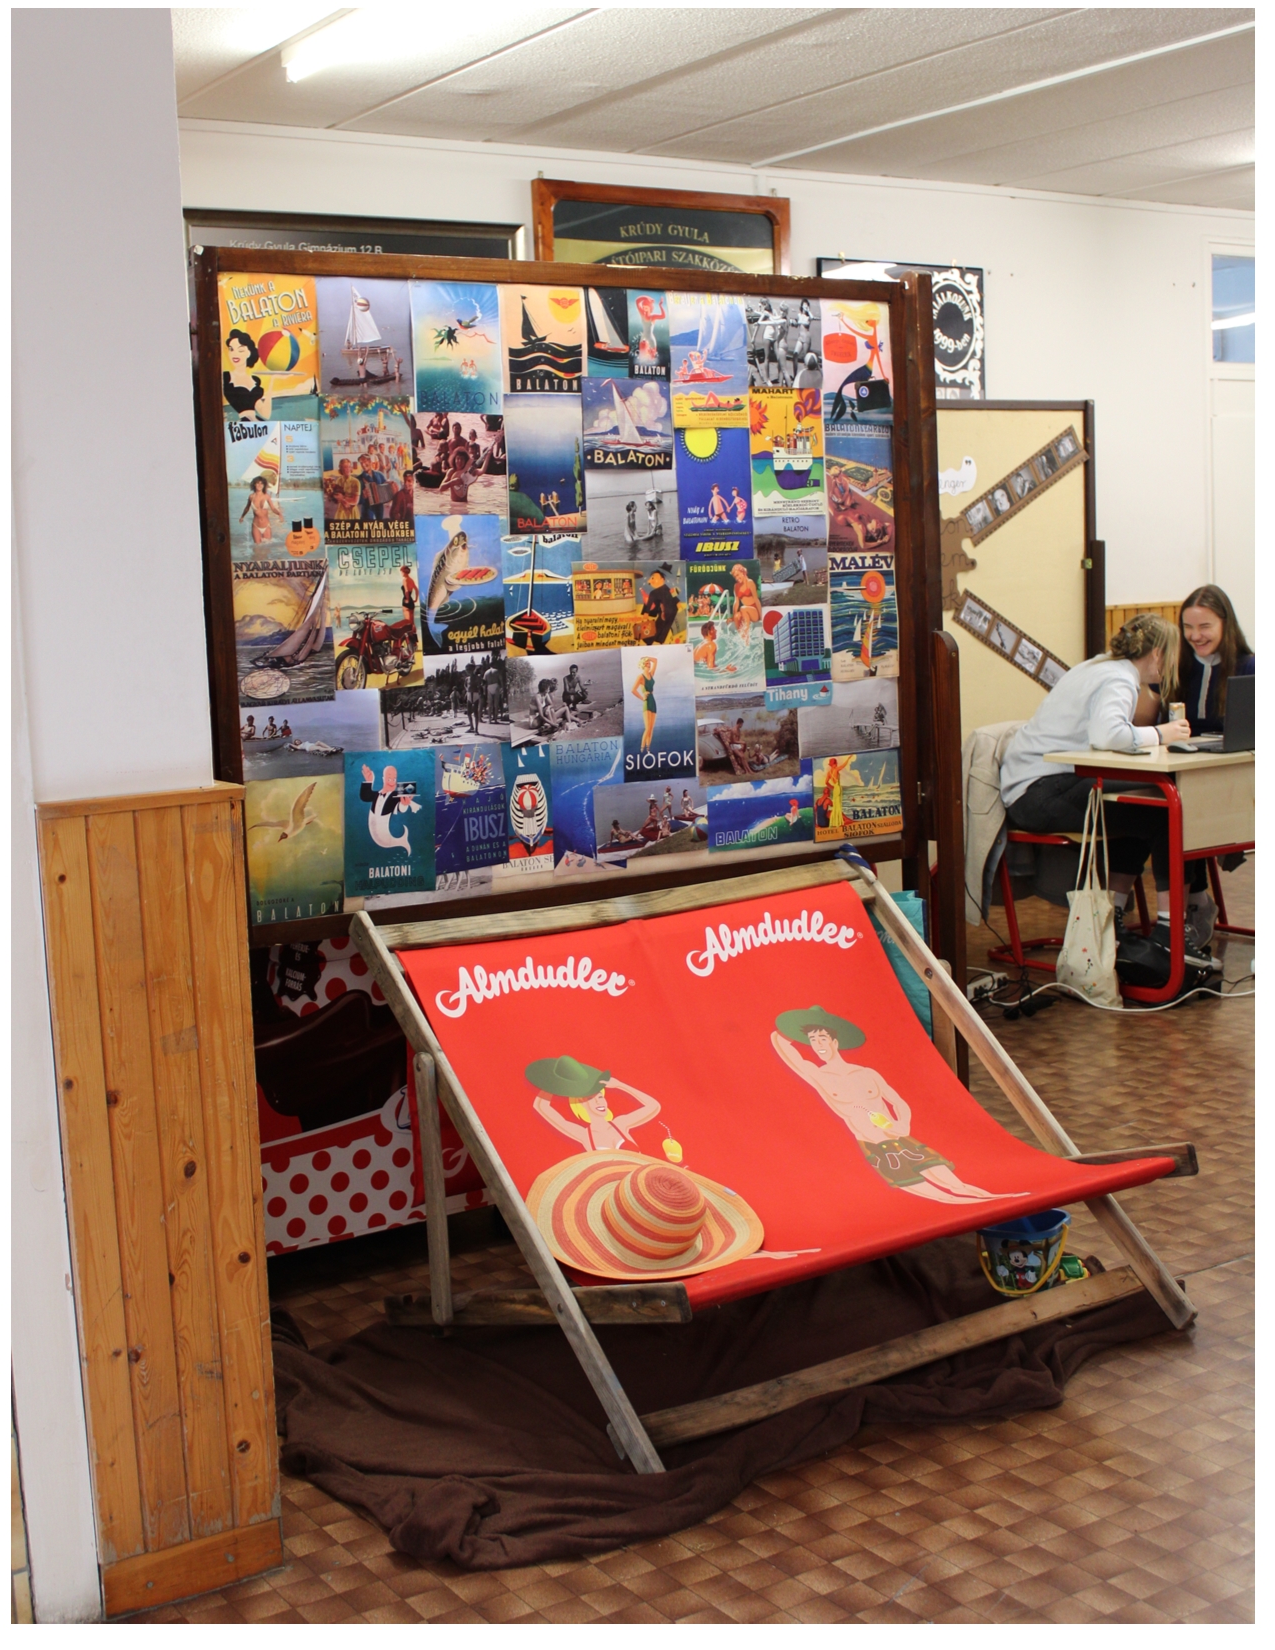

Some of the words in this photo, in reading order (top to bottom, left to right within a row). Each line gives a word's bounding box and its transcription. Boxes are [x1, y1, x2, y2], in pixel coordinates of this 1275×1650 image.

[619, 221, 664, 239] KRÚDY
[668, 224, 711, 243] GYULA
[226, 288, 309, 325] BALATON
[932, 290, 973, 322] ALÁLKOZUNK
[634, 364, 666, 376] BALATON
[516, 379, 578, 391] BALATON
[420, 390, 499, 407] BALATON
[284, 423, 313, 432] NAPTEJ
[594, 449, 665, 467] BALATON
[329, 521, 351, 530] SZÉP
[354, 522, 360, 530] A
[363, 520, 384, 530] NYÁR
[388, 520, 410, 530] VÉGE
[517, 516, 578, 529] BALATON
[783, 525, 809, 533] BALATON
[331, 530, 368, 539] BALATONI
[695, 541, 740, 553] IBUSZ
[337, 545, 413, 569] CSEPEL
[828, 553, 894, 571] MALÉV
[243, 571, 285, 579] BALATON
[448, 626, 478, 643] egyél
[480, 621, 505, 636] halat
[766, 688, 808, 702] Tihany
[556, 740, 619, 755] BALATON
[556, 751, 612, 765] HUNGARIA
[625, 750, 695, 771] SIÓFOK
[852, 804, 901, 821] BALATON
[463, 812, 506, 842] IBUSZ
[816, 828, 839, 836] HOTEL
[842, 821, 877, 832] BALATON
[715, 826, 778, 847] BALATON
[502, 856, 542, 870] BALATON
[368, 864, 412, 879] BALATONI
[256, 900, 341, 923] BALATON
[686, 909, 858, 978] Almdudler
[435, 955, 630, 1019] Almdudler
